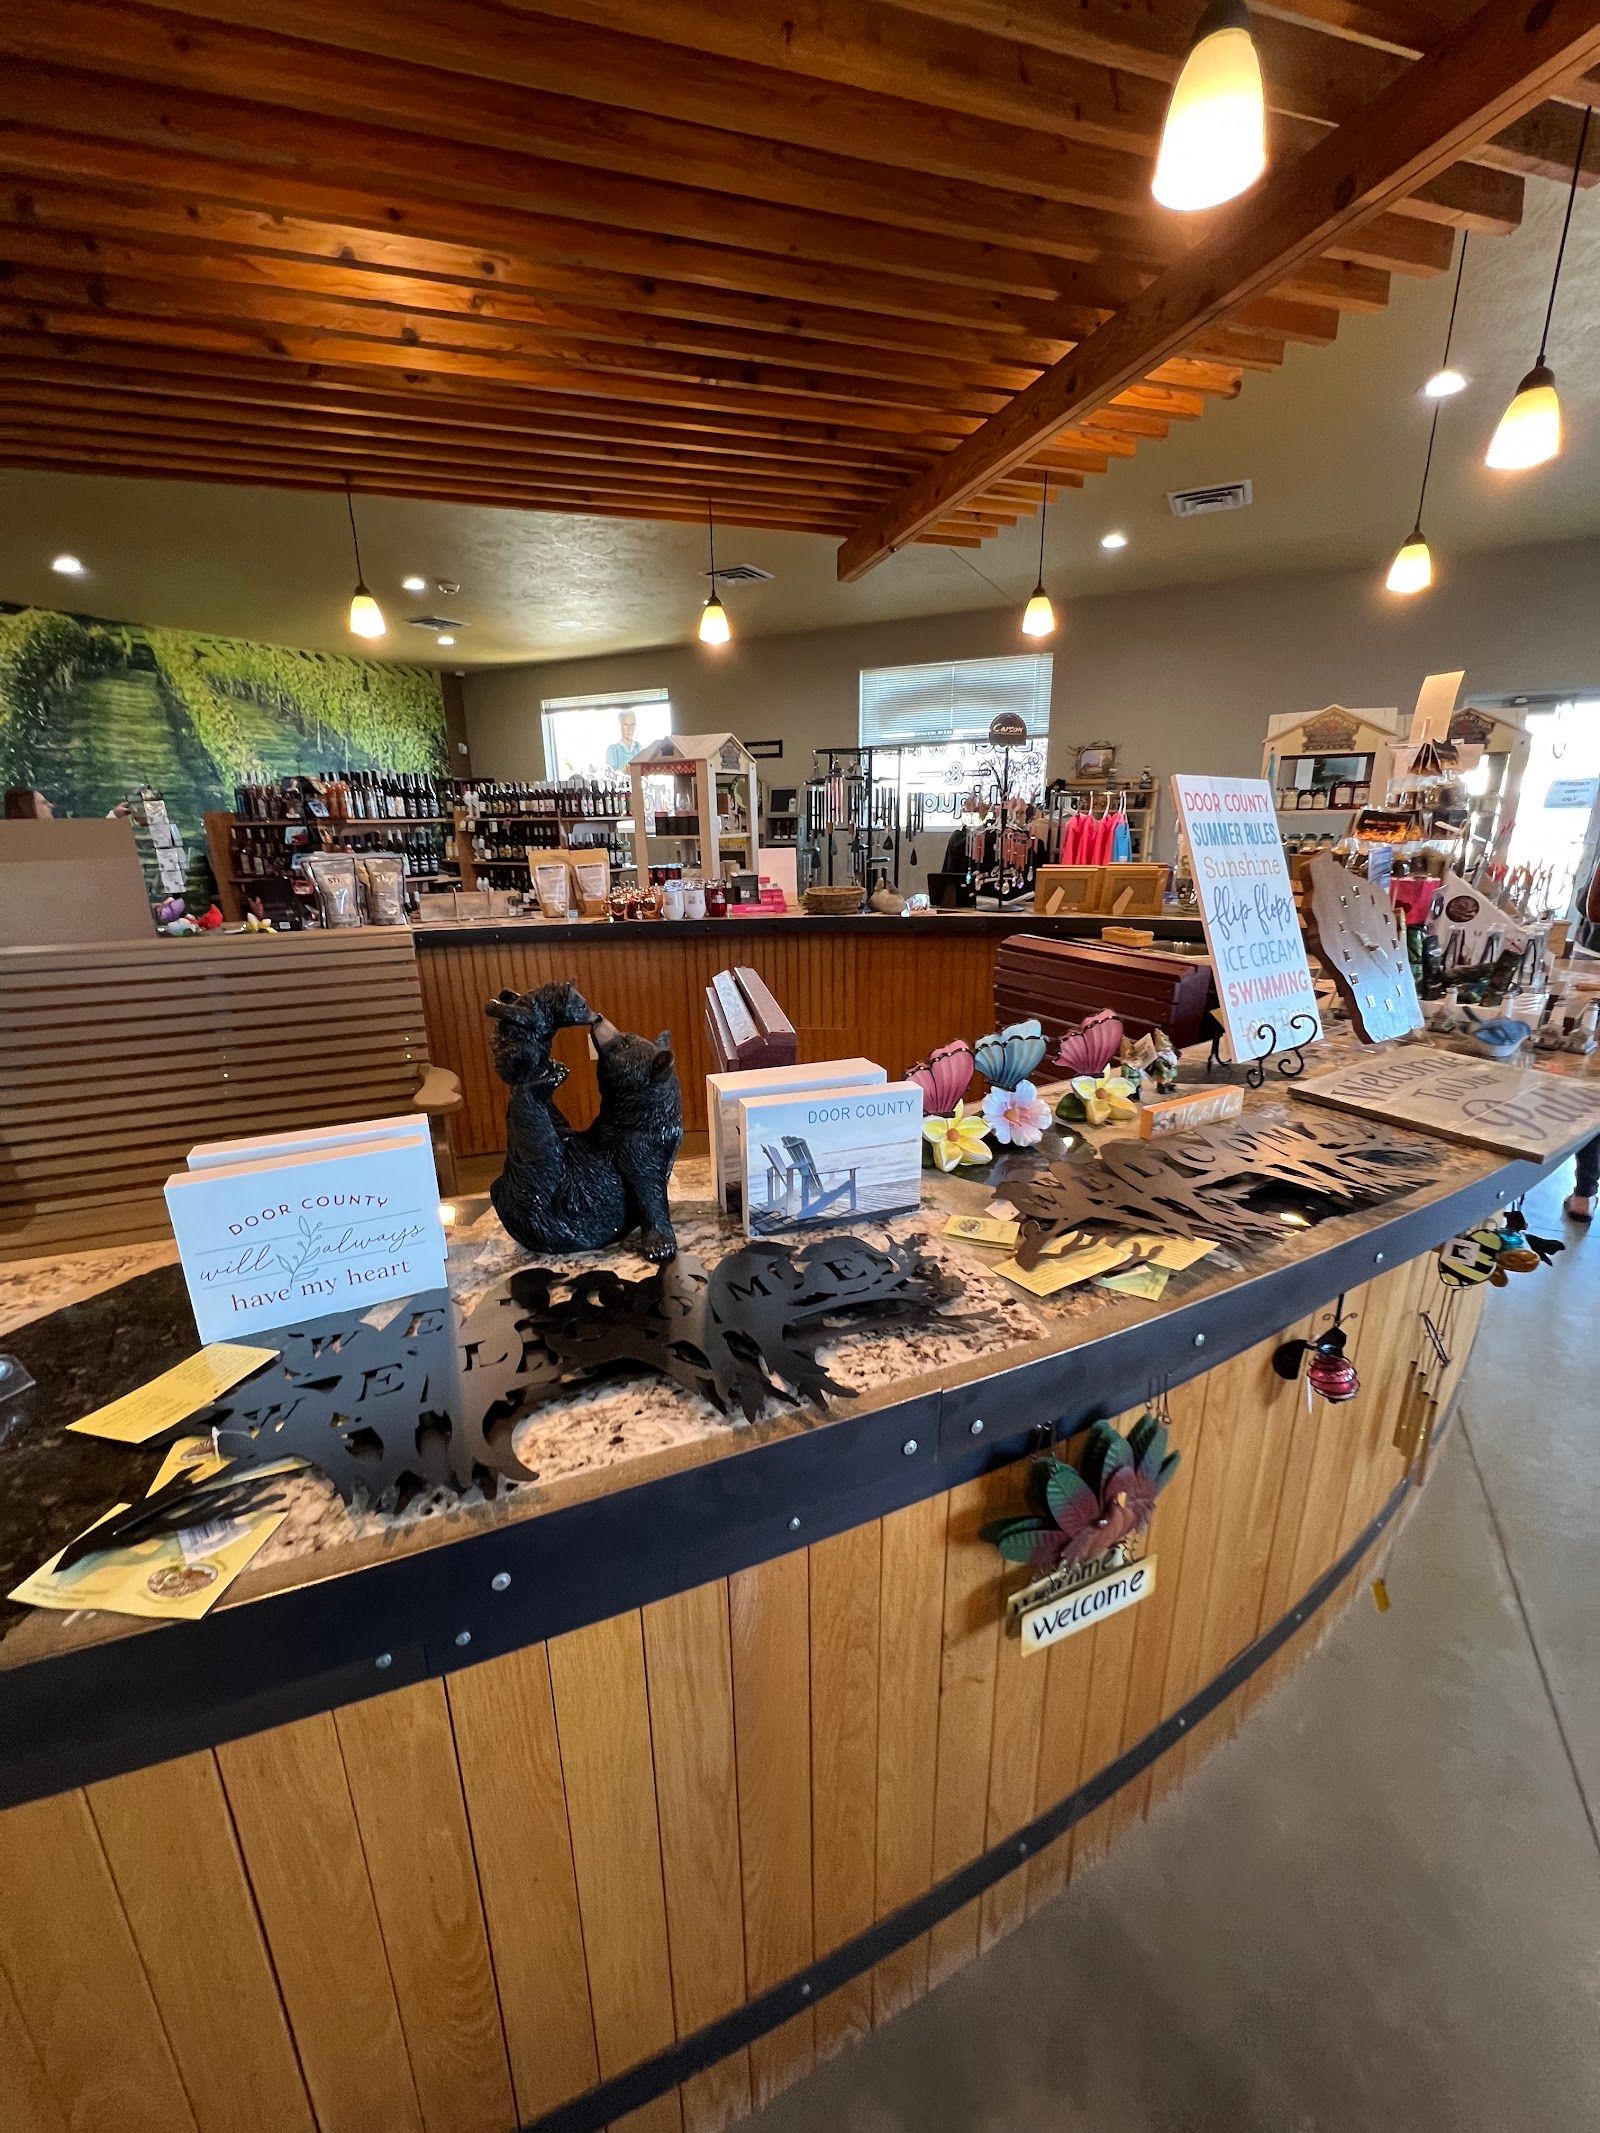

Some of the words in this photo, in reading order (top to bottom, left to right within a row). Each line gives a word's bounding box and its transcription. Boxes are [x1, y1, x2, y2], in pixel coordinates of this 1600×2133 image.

[1184, 792, 1221, 812] DOOR
[1224, 794, 1268, 813] COUNTY
[1192, 823, 1244, 846] SUMMER
[1244, 822, 1277, 845] RULES
[1204, 853, 1280, 878] Sunshine
[1208, 886, 1252, 940] flip
[1254, 883, 1293, 935] flops
[1223, 946, 1248, 972] ICE
[1250, 938, 1300, 967] CREAM
[1228, 969, 1309, 1007] SWIMMING
[1331, 1056, 1459, 1101] Welcome
[1413, 1080, 1459, 1102] To
[1436, 1073, 1502, 1090] Our
[808, 1108, 850, 1124] DOOR
[855, 1099, 915, 1118] COUNTY
[228, 1204, 291, 1236] DOOR
[301, 1194, 389, 1210] COUNTY
[200, 1244, 275, 1282] will
[323, 1225, 425, 1254] always
[231, 1287, 291, 1312] have
[301, 1275, 338, 1297] my
[347, 1259, 412, 1287] heart
[1032, 1569, 1145, 1640] Welcome
